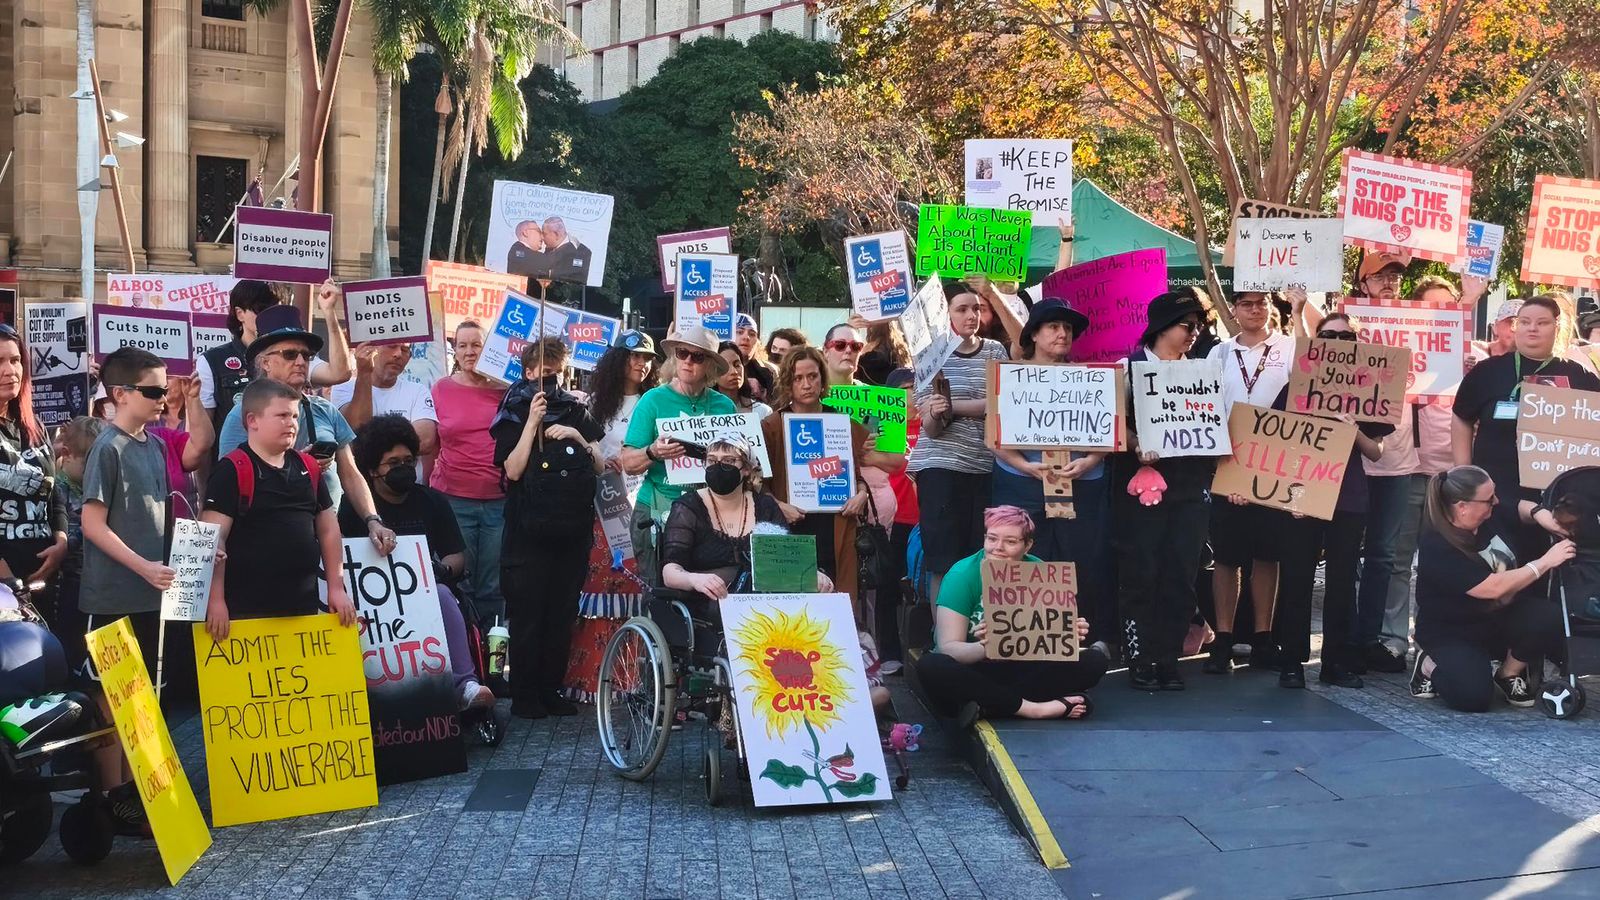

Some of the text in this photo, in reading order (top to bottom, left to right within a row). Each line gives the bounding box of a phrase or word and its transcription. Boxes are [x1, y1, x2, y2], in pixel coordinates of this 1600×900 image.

[998, 147, 1068, 171] #KEEP
[1024, 172, 1056, 191] THE
[1007, 193, 1069, 212] PROMISE
[1355, 177, 1449, 212] STOP THE
[956, 207, 988, 223] Was
[990, 207, 1032, 226] Never
[1351, 197, 1453, 233] NDIS CUTS
[1546, 206, 1600, 231] STOP
[241, 232, 327, 248] Disabled people
[928, 224, 1024, 244] About Fraud.
[1262, 228, 1296, 240] Deserve
[1302, 229, 1312, 243] to
[1541, 228, 1591, 253] NDIS
[243, 244, 325, 260] deserve dignity
[678, 242, 709, 254] NDIS
[962, 239, 1017, 257] Blatant
[1258, 246, 1298, 267] LIVE
[1470, 248, 1488, 257] NOT
[857, 268, 881, 279] ACCESS
[920, 253, 1023, 280] EUGENICS!
[109, 280, 164, 292] ALBOS
[873, 272, 896, 290] NOT
[1243, 280, 1266, 291] Protect
[167, 282, 218, 303] CRUEL
[365, 293, 401, 306] NDIS
[438, 282, 478, 301] STOP
[683, 289, 708, 298] ACCESS
[29, 307, 65, 319] YOU WOULDN'T
[699, 297, 722, 311] NOT
[883, 300, 907, 312] AUKUS
[355, 307, 415, 321] benefits
[1380, 316, 1459, 329] PEOPLE DESERVE DIGNITY
[29, 319, 55, 331] CUT OFF
[106, 320, 181, 336] Cuts harm
[369, 322, 410, 335] us all
[499, 325, 525, 341] ACCESS
[573, 327, 598, 338] NOT
[29, 332, 66, 343] LIFE SUPPORT.
[120, 338, 169, 351] people
[196, 332, 227, 342] harm
[1414, 330, 1451, 352] THE
[1307, 339, 1388, 368] blood on
[1010, 367, 1106, 384] THE STATES
[1143, 372, 1220, 396] I wouldn't
[1321, 365, 1367, 386] your
[877, 394, 906, 408] NDIS
[1011, 388, 1105, 408] WILL DELIVER
[1161, 398, 1214, 412] be here
[1305, 378, 1391, 418] hands
[877, 409, 906, 424] DEAD
[1522, 393, 1600, 424] Stop the
[661, 414, 747, 432] CUT THE RORTS
[1027, 407, 1112, 436] NOTHING
[1150, 411, 1221, 427] without the
[694, 429, 719, 441] NOT
[1014, 432, 1104, 445] We Already know that
[1162, 427, 1217, 450] NDIS
[1252, 408, 1334, 452] YOU'RE
[1520, 432, 1592, 459] Don't put
[794, 452, 822, 460] ACCESS
[1226, 438, 1345, 484] KILLING
[812, 460, 837, 475] NOT
[1531, 460, 1551, 471] on
[1252, 475, 1305, 504] US
[603, 503, 628, 515] ACCESS
[172, 554, 186, 564] THEY
[180, 567, 203, 577] SUPPORT
[989, 562, 1071, 585] WE ARE
[178, 592, 194, 602] STOLE
[988, 585, 1076, 608] NOT YOUR
[364, 608, 416, 645] the
[991, 608, 1074, 635] SCAPE
[91, 632, 121, 674] Justice
[205, 629, 336, 668] ADMIT THE
[998, 633, 1075, 658] GOATS
[363, 636, 447, 688] CUTS
[763, 647, 821, 669] STOP
[247, 665, 309, 699] LIES
[780, 675, 818, 691] THE
[772, 692, 834, 713] CUTS
[205, 690, 369, 745] PROTECT THE
[124, 718, 140, 752] End
[230, 736, 374, 795] VULNERABLE
